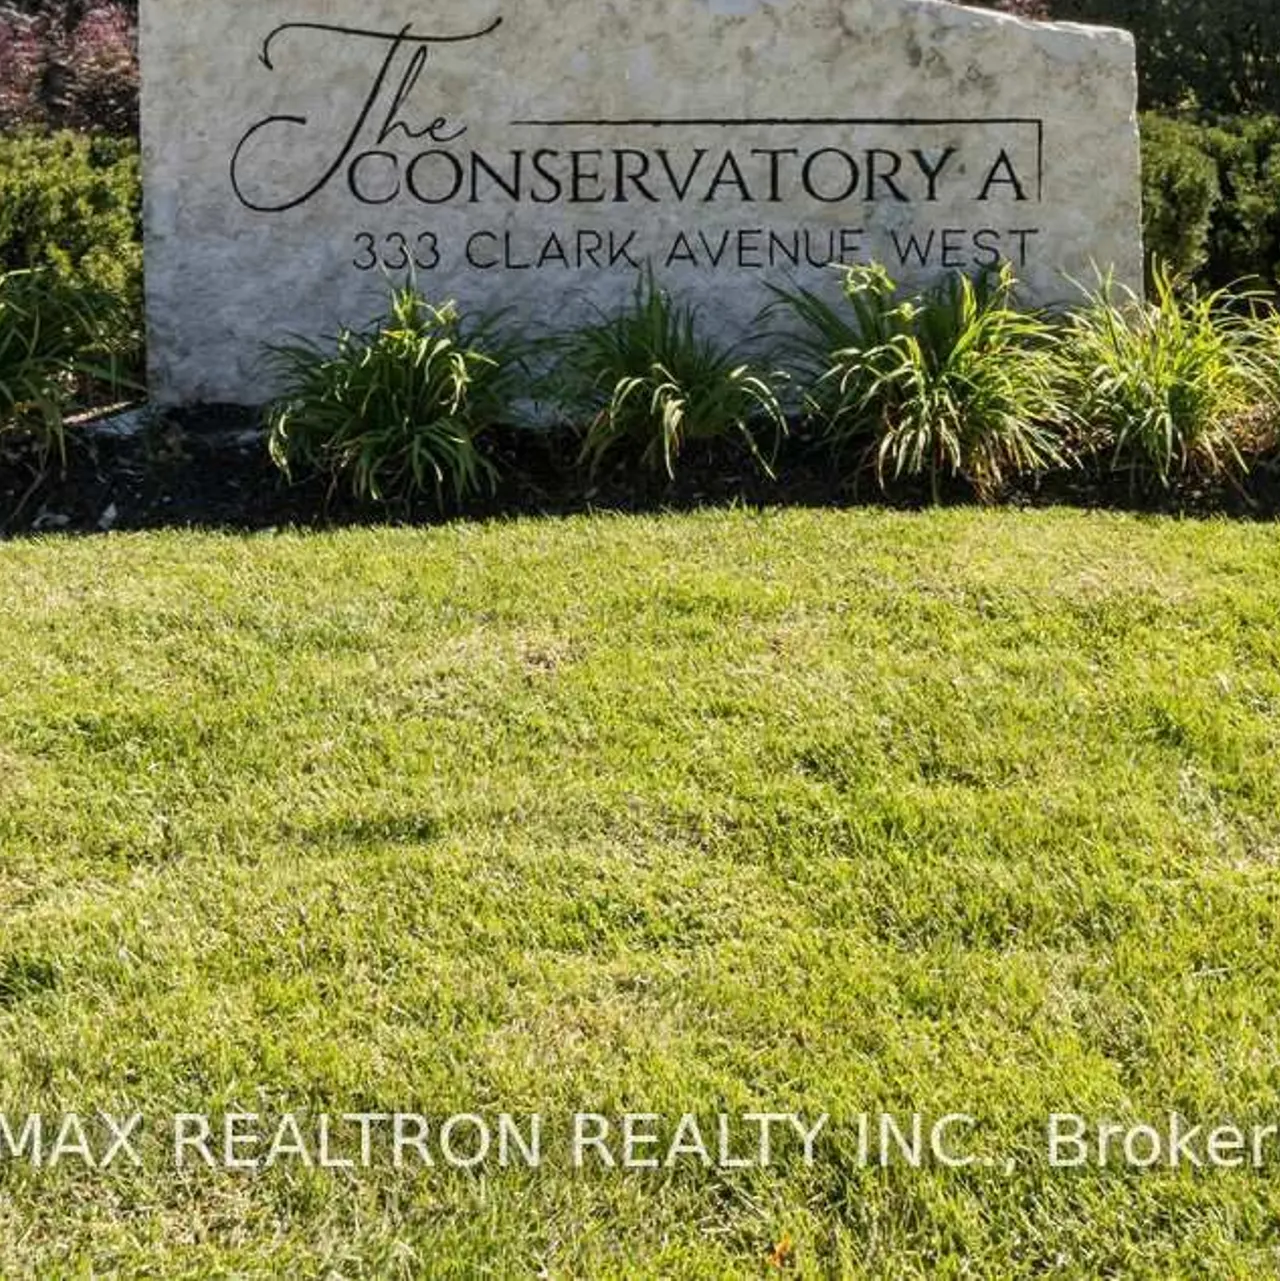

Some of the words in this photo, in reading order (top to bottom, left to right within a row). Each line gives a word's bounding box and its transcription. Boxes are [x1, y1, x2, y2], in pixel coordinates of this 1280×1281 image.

[230, 17, 503, 212] The
[348, 147, 957, 204] CONSERVATORY
[977, 148, 1028, 201] A
[352, 232, 440, 270] 333
[466, 231, 641, 270] CLARK
[666, 230, 865, 268] AVENUE
[890, 228, 1039, 269] WEST
